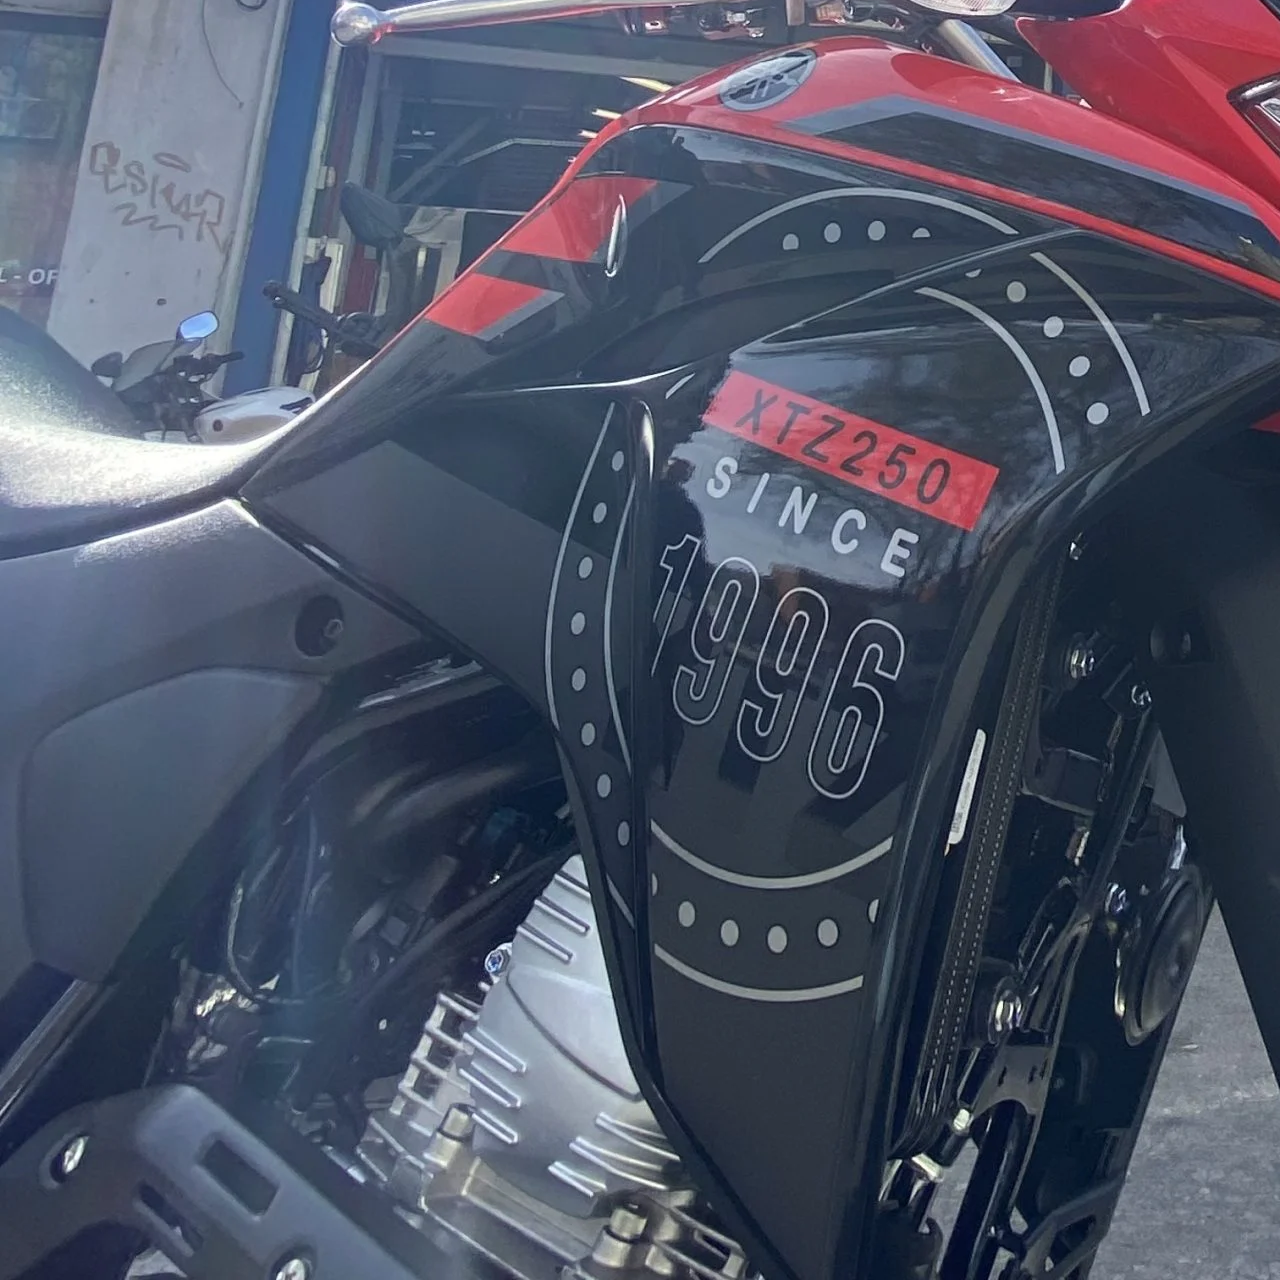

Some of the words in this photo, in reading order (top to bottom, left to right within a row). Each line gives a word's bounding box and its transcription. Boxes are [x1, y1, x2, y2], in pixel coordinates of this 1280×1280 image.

[735, 388, 952, 506] XTZ250
[706, 456, 920, 578] SINCE
[651, 533, 906, 800] 1996
